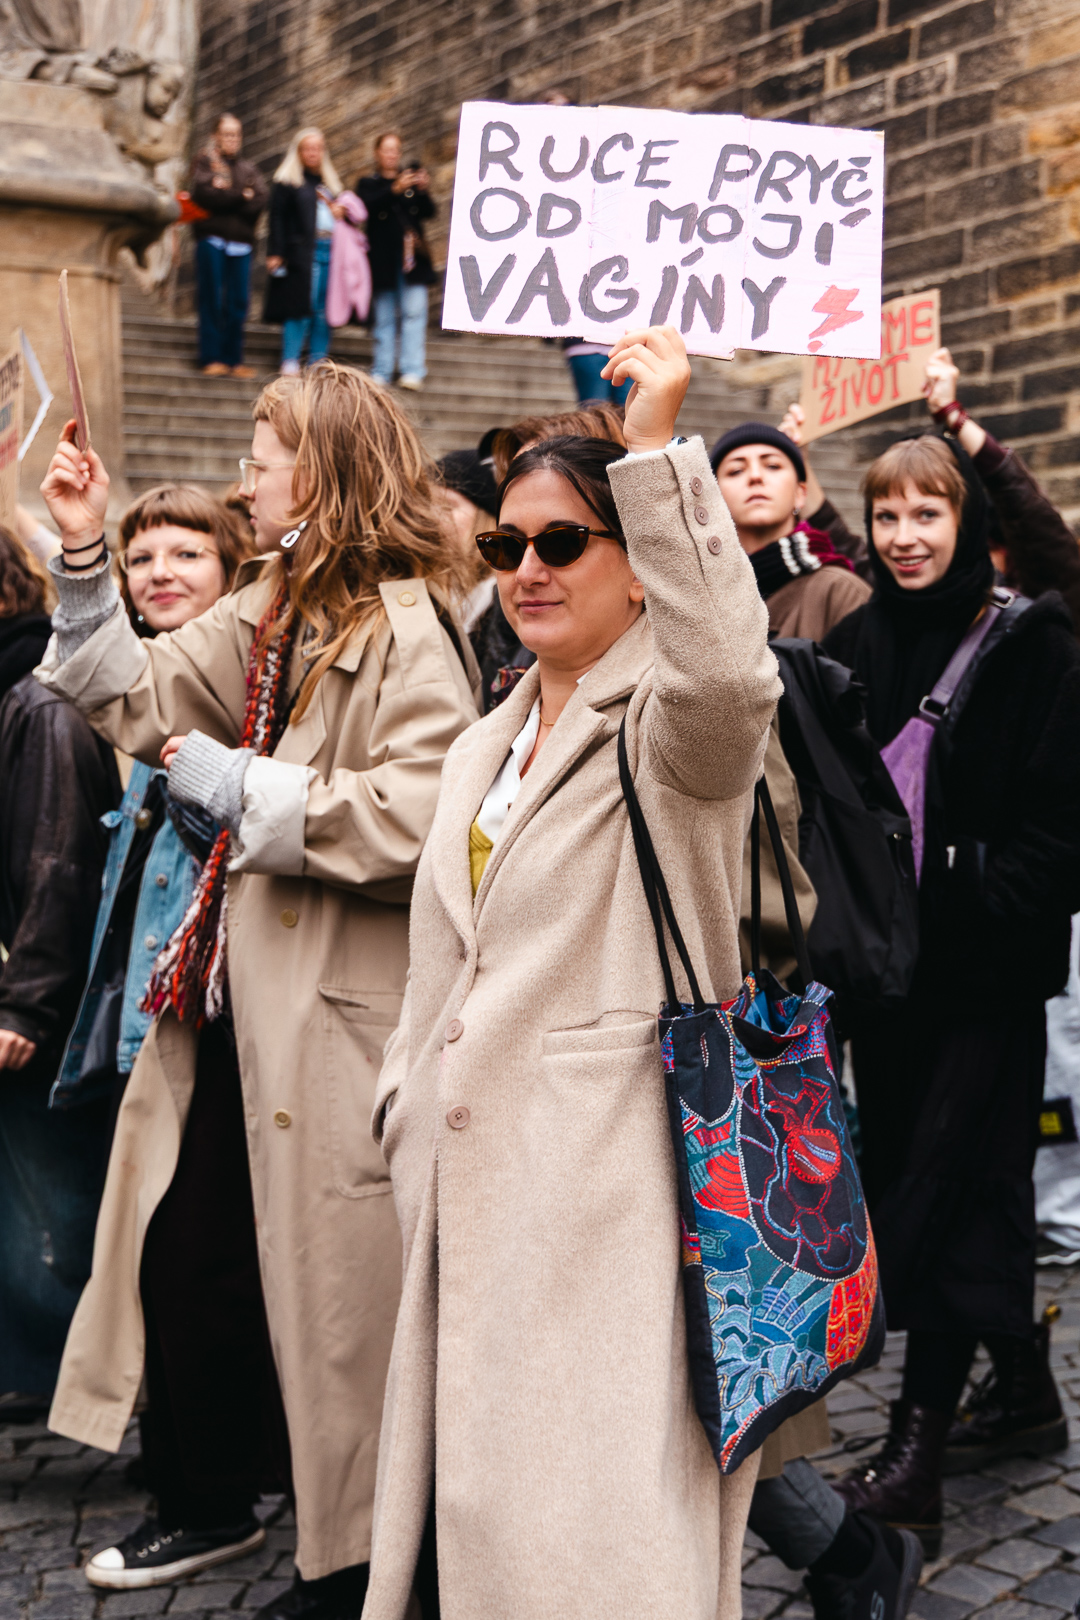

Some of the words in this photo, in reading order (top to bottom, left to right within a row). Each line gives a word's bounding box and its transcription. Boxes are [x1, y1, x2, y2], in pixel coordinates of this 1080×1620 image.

[479, 121, 679, 189] RUCE
[708, 144, 873, 208] PRYČ
[469, 187, 582, 242] OD
[645, 199, 872, 266] MOJÍ
[458, 247, 787, 341] VAGÍNY
